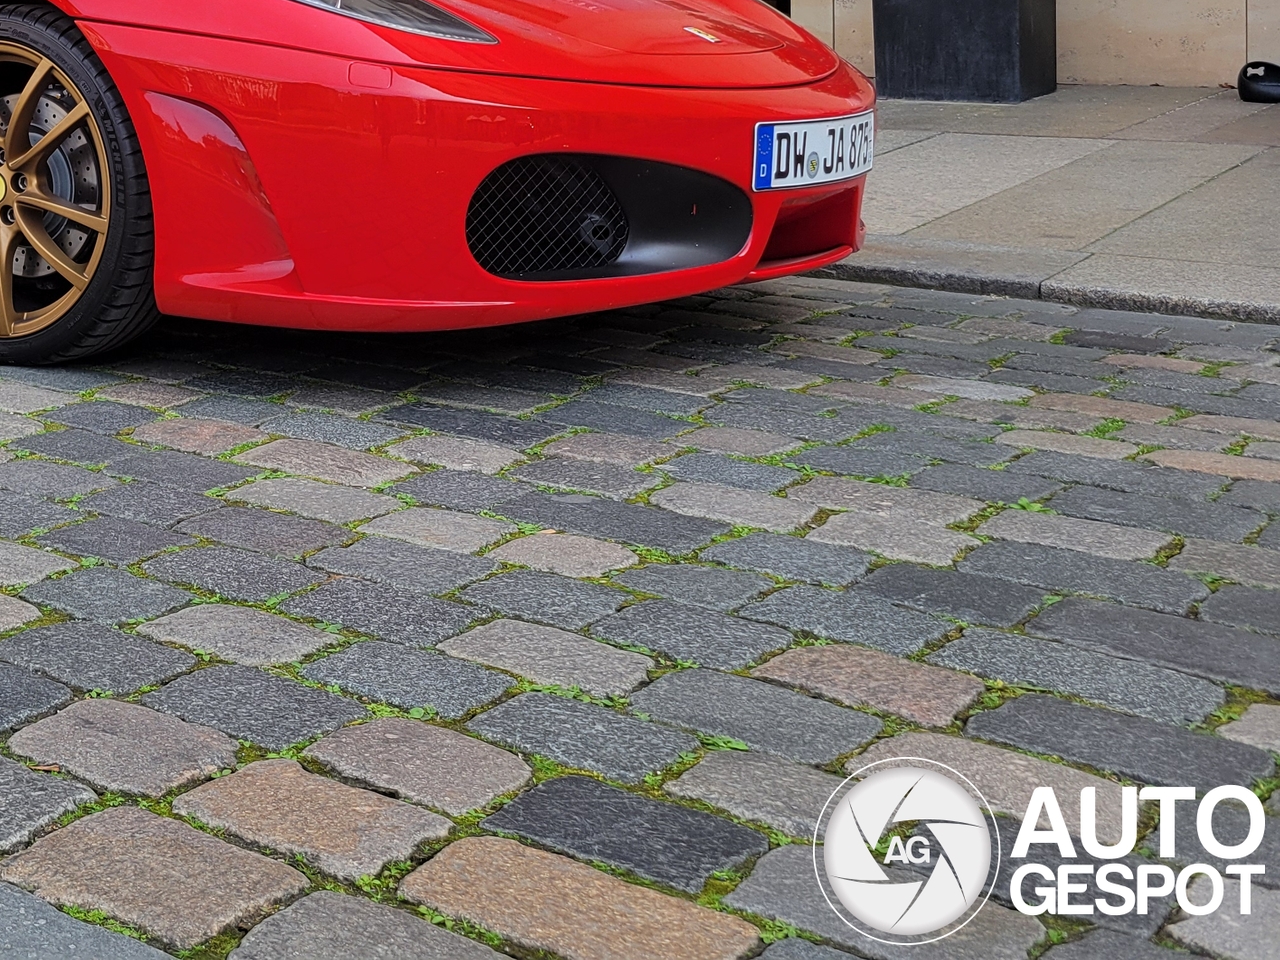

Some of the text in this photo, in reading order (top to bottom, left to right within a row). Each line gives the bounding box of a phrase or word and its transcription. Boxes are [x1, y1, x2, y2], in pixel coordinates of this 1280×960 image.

[104, 118, 126, 207] MICHELIN
[759, 163, 767, 178] D
[774, 131, 808, 180] DW
[823, 127, 845, 175] JA
[849, 121, 868, 170] 875
